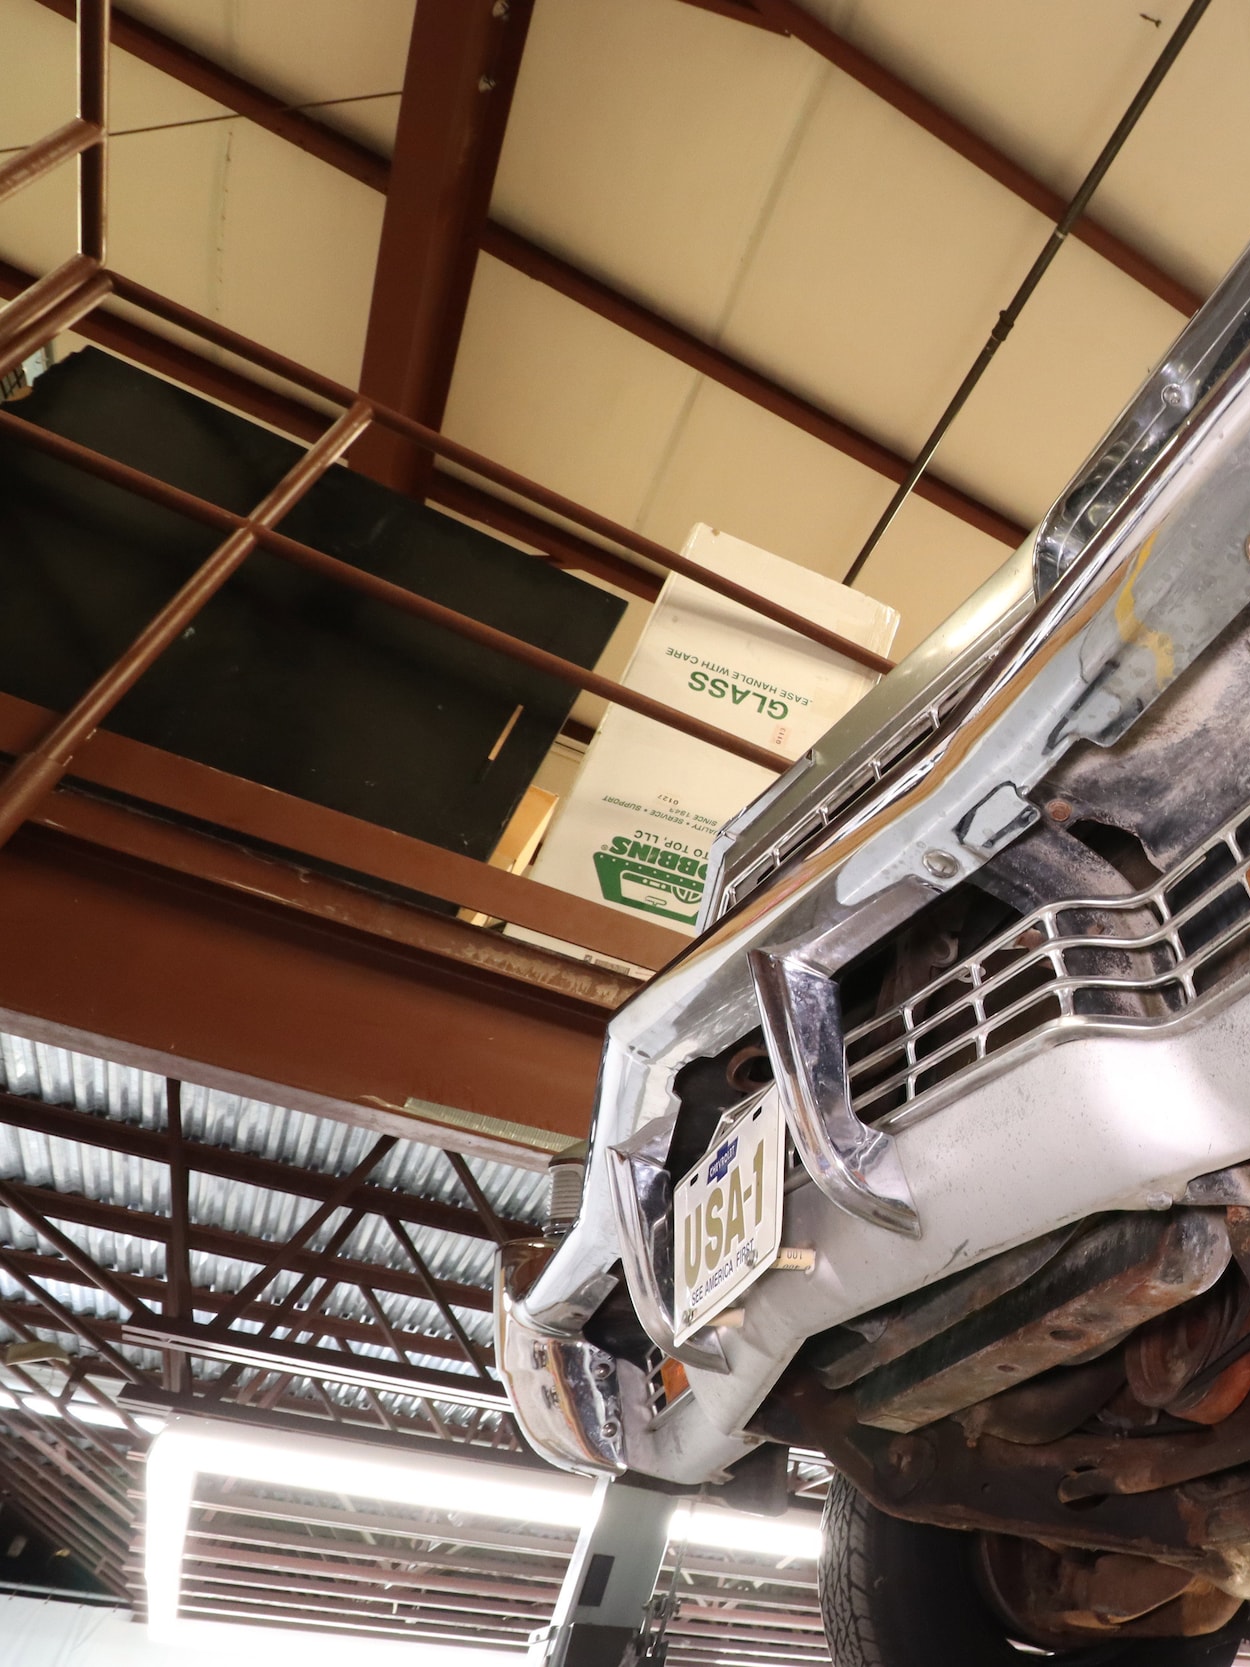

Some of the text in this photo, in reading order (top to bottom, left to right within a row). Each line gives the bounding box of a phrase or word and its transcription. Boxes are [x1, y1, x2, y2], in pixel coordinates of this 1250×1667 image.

[665, 647, 813, 706] EASE HANDLE WITH CARE
[687, 670, 789, 720] GLASS
[602, 795, 642, 811] SUPPORT
[649, 809, 684, 825] SERVICE
[693, 814, 718, 827] SINCE
[633, 829, 659, 844] LLC
[664, 837, 690, 850] TOP,
[709, 1145, 736, 1177] CHEVROLET
[684, 1138, 764, 1289] USA-1
[691, 1238, 755, 1306] SEE AMERICA FIRST
